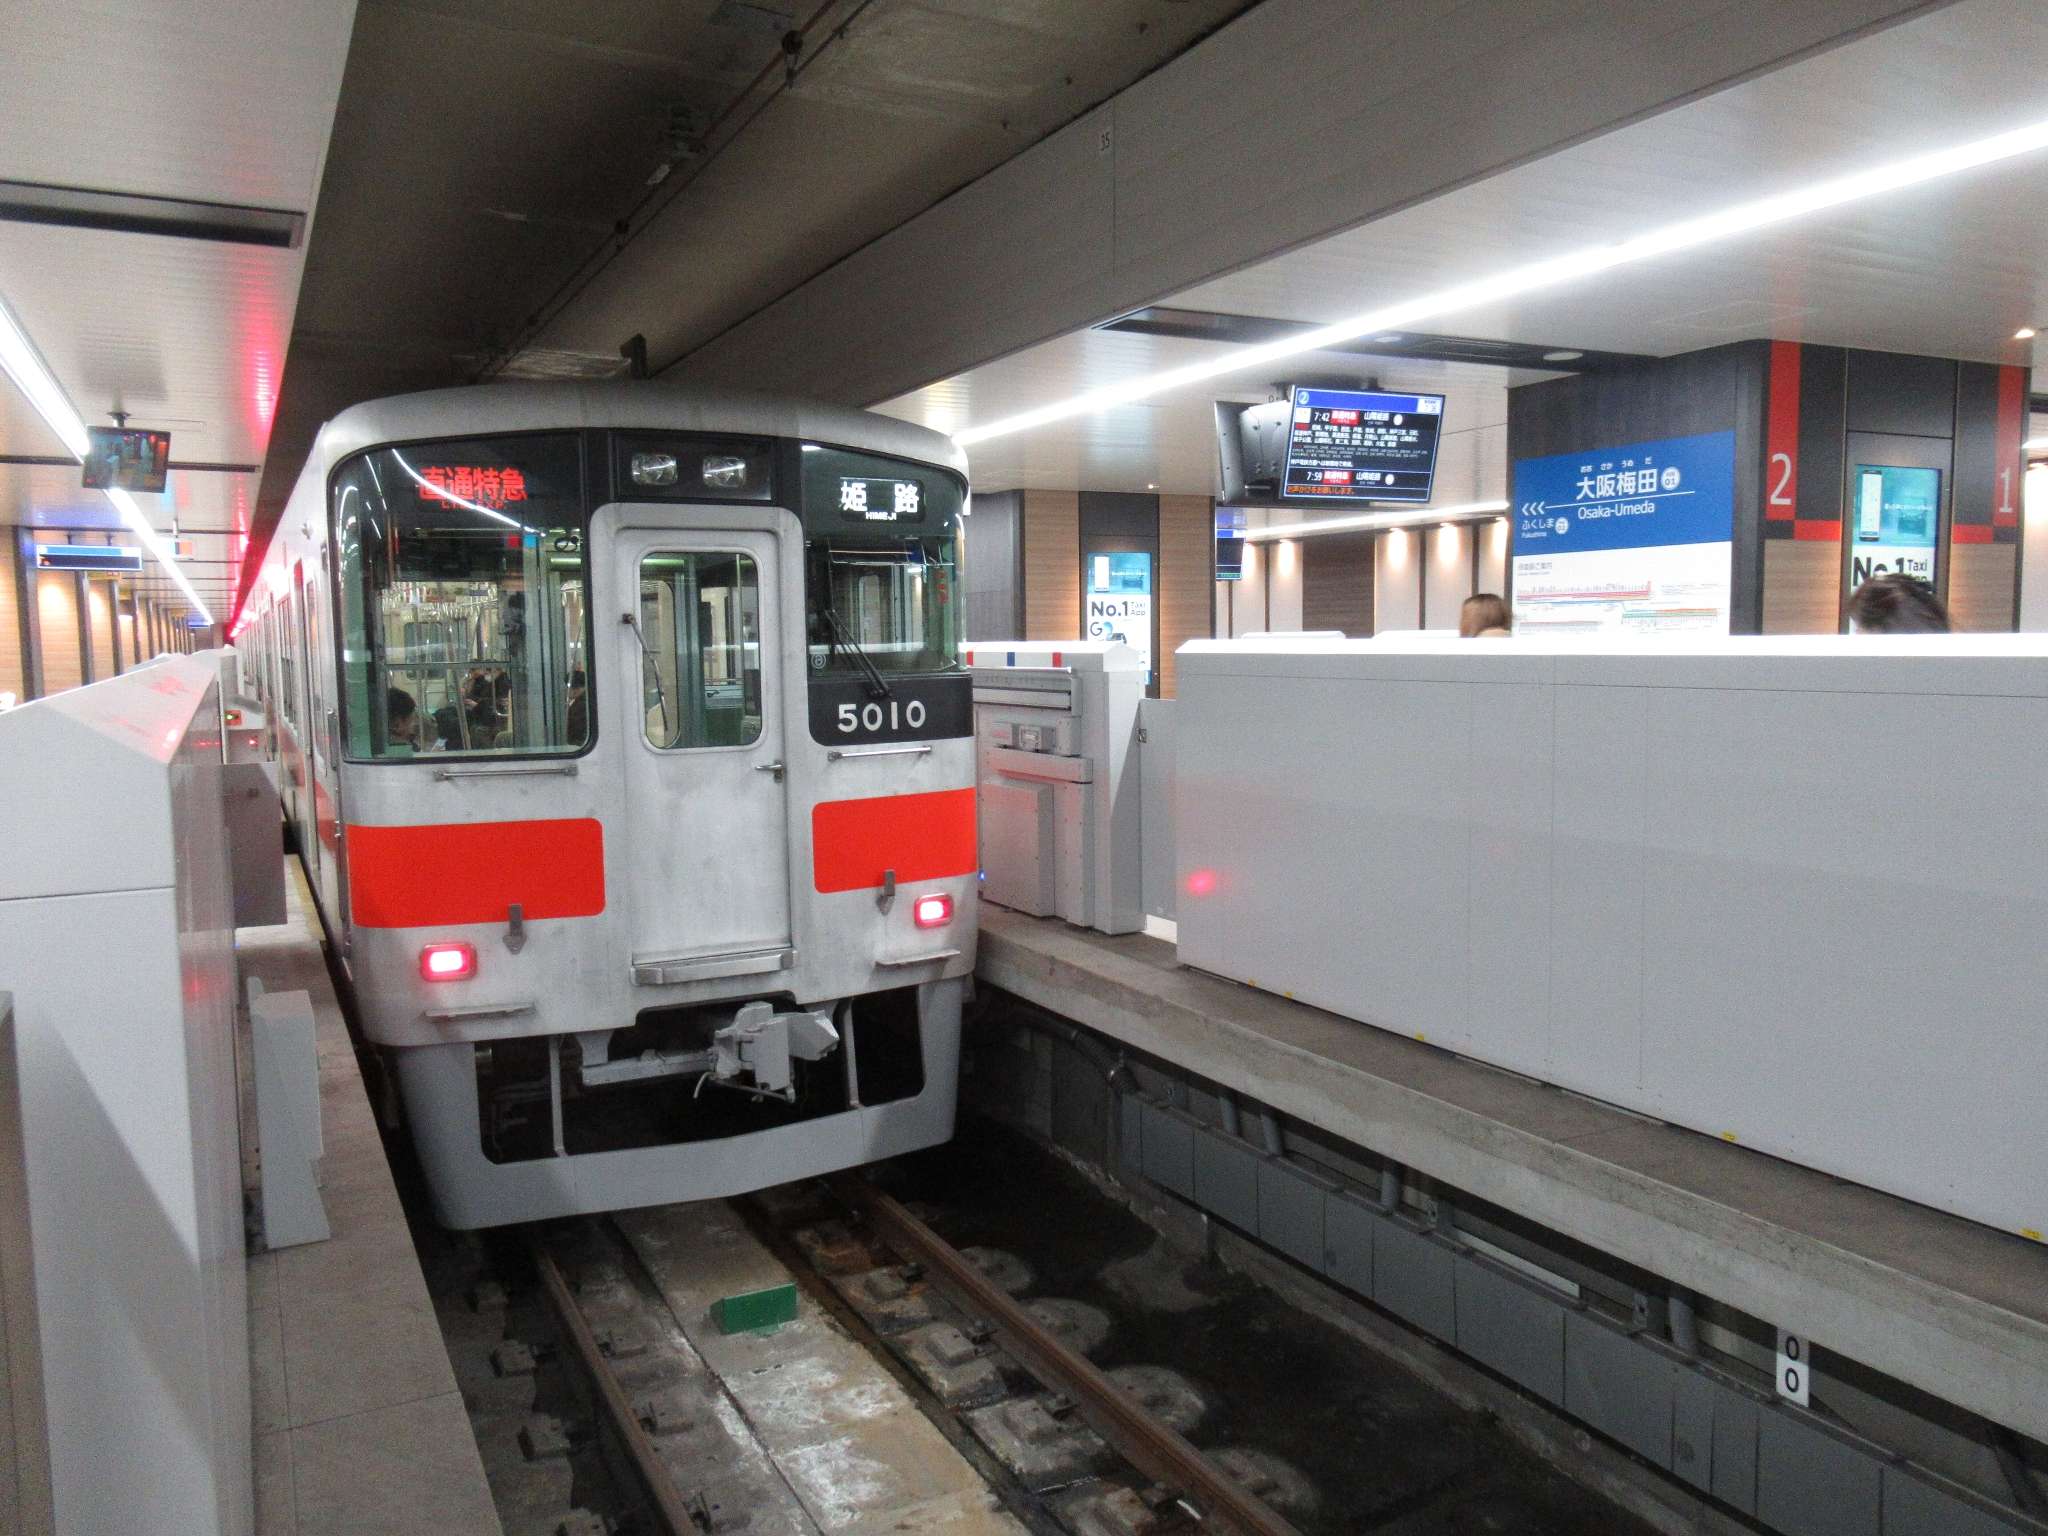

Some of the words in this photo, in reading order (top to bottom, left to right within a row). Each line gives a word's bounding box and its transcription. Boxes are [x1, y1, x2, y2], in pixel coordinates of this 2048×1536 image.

[1314, 413, 1330, 422] 7:42
[419, 466, 529, 501] 直通特急
[1307, 471, 1322, 481] 7:59
[1576, 468, 1658, 500] 大阪梅田
[1769, 453, 1792, 505] 2
[840, 481, 920, 512] 姫路
[2000, 467, 2013, 513] 1
[865, 512, 897, 520] HIMEJI
[1578, 500, 1655, 519] Osaka-Umeda
[1521, 518, 1555, 530] ふくしま
[1907, 559, 1928, 571] Taxi
[1091, 600, 1128, 617] No.1
[838, 700, 926, 733] 5010
